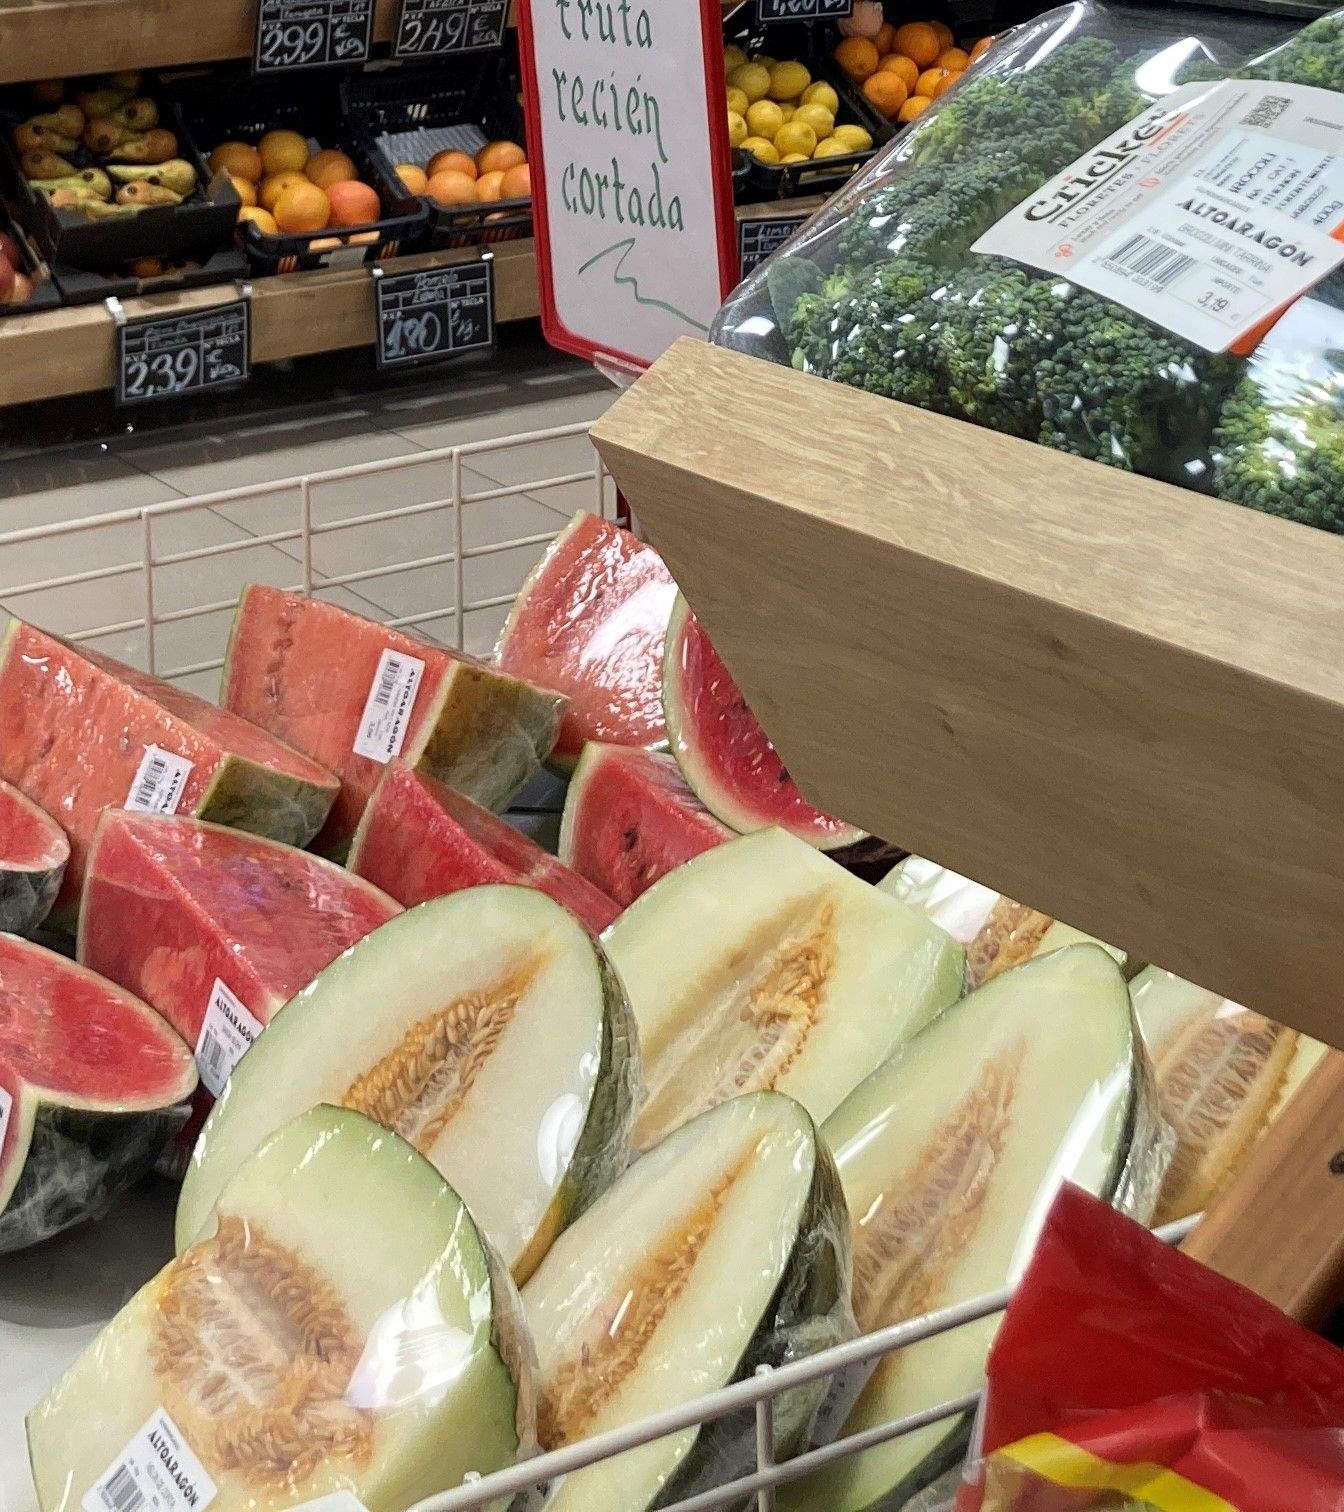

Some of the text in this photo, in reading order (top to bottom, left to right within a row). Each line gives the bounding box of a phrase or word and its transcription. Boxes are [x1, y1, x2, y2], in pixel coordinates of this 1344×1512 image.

[553, 67, 668, 163] recién
[561, 157, 684, 232] cortada
[1024, 110, 1182, 222] Cricket
[126, 348, 199, 397] 2,39
